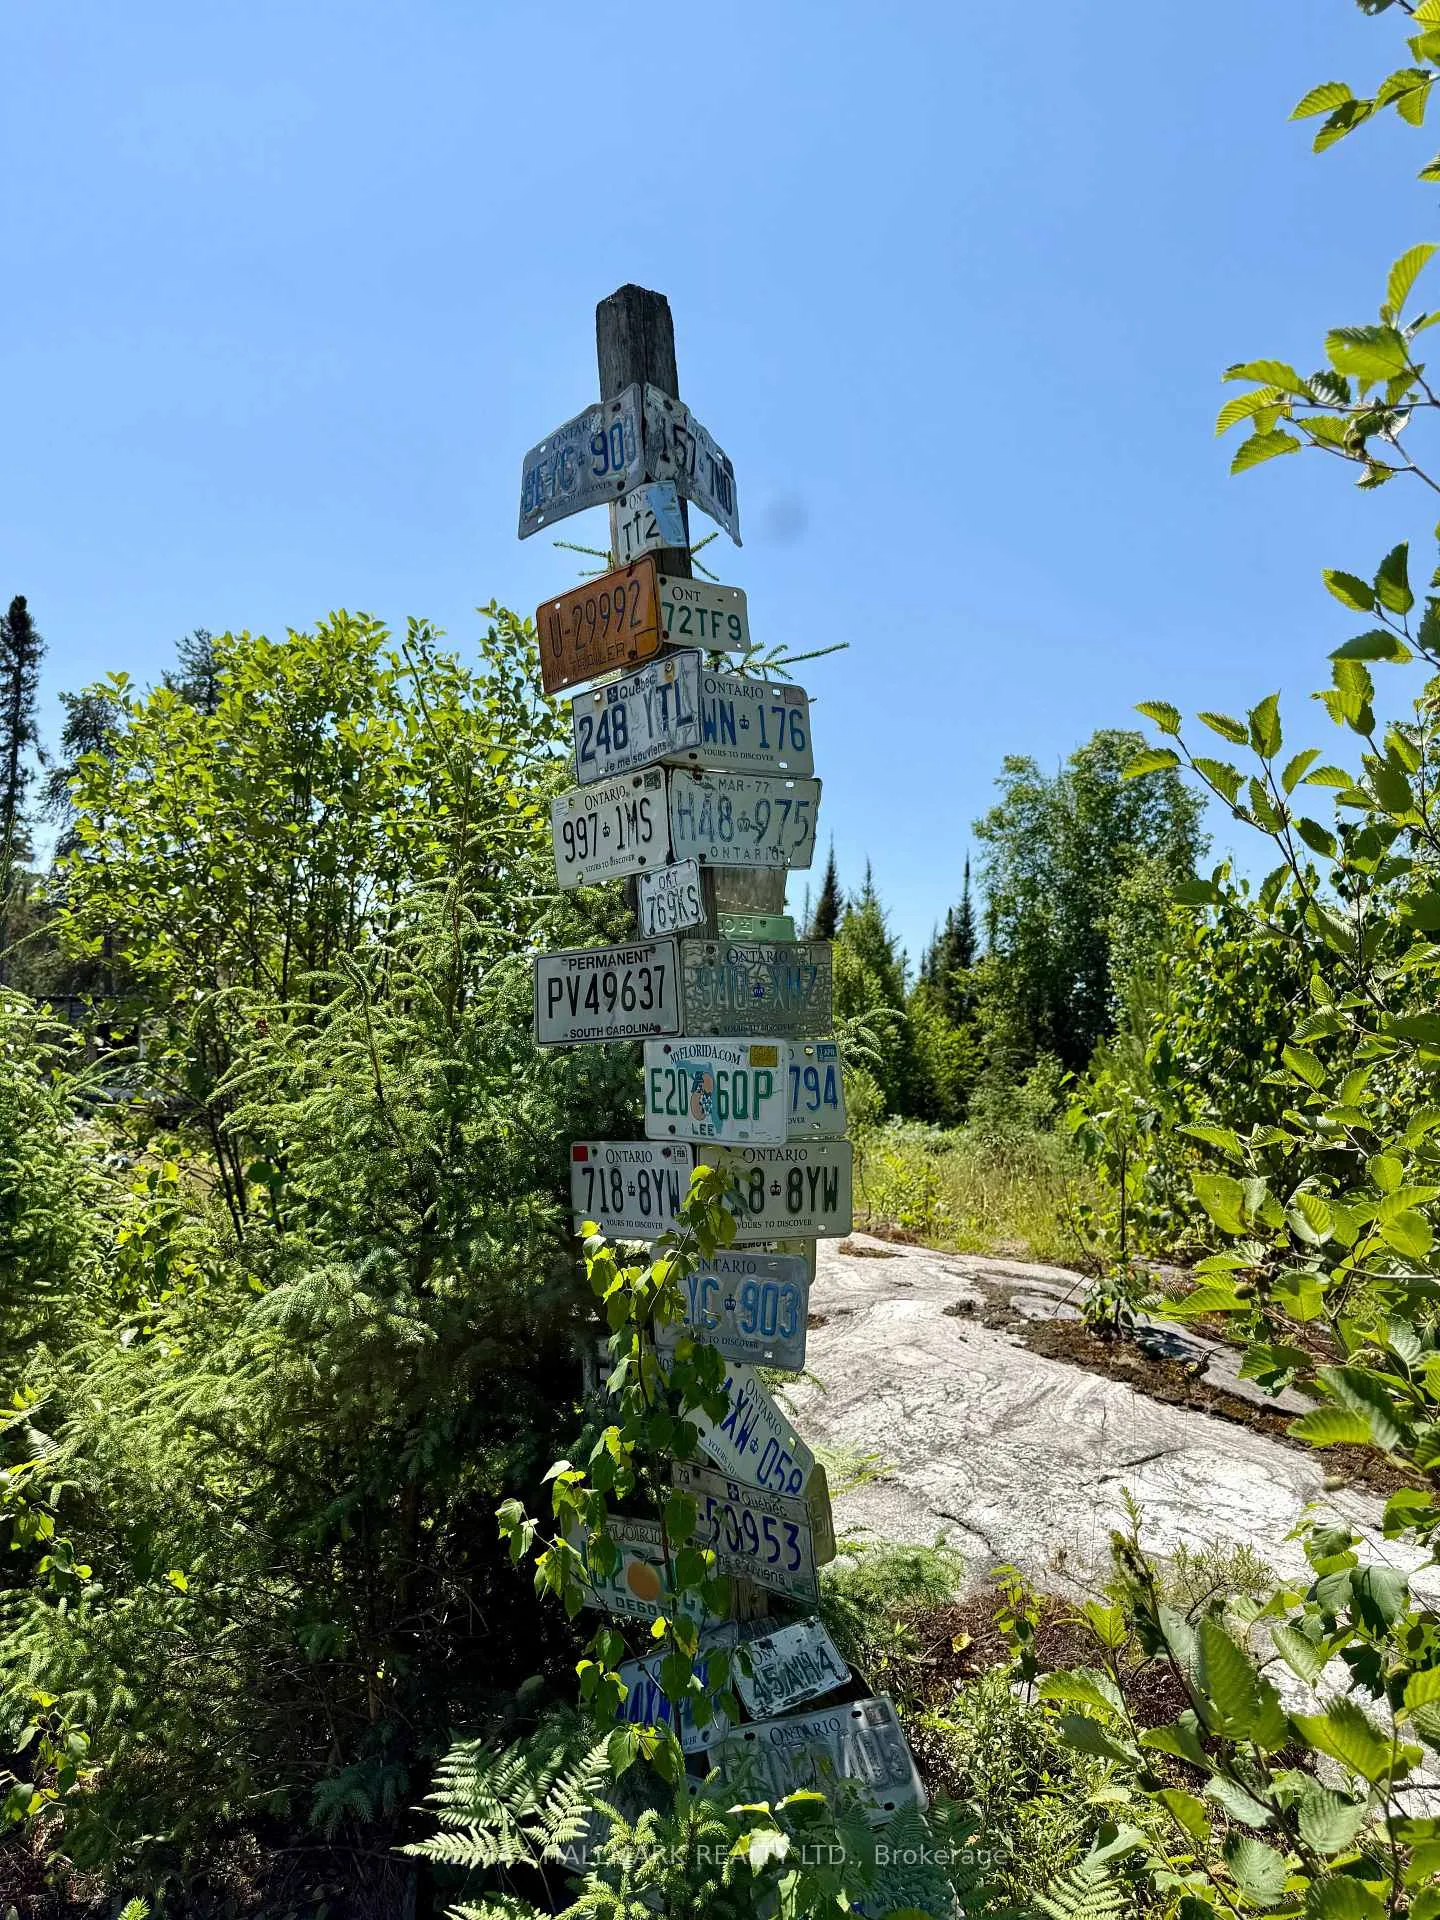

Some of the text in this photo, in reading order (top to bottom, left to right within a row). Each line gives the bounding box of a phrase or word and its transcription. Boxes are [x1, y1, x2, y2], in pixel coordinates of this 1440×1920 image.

[672, 586, 701, 601] ONT
[549, 579, 641, 658] U-29992
[662, 602, 742, 641] 72TF9
[704, 678, 764, 699] ONTARIO
[578, 703, 628, 763] 248
[702, 697, 806, 752] WN 176
[604, 740, 668, 773] Je me souviens
[703, 748, 774, 761] YOURS TO DISCOVER
[584, 785, 626, 811] ONTARIO
[562, 797, 653, 863] 997 1MS
[755, 798, 810, 847] 975
[710, 845, 780, 861] ONTARIO
[658, 870, 678, 890] ONT
[568, 949, 650, 971] PERMANENT
[726, 948, 789, 965] ONTARIO
[547, 964, 665, 1019] PV49637
[569, 1022, 656, 1039] SOUTH CAROLINA
[670, 1044, 741, 1066] MYFLORIDA.COM
[651, 1067, 688, 1116] E20
[788, 1064, 839, 1112] 794
[692, 1123, 715, 1137] LEE
[605, 1148, 653, 1165] ONTARIO
[743, 1147, 808, 1164] ONTARIO
[582, 1167, 681, 1217] 718 8YW
[787, 1166, 839, 1214] 8YW
[606, 1219, 624, 1227] YOURS
[626, 1220, 634, 1228] TO
[737, 1218, 812, 1229] YOURS TO DISCOVER
[701, 1258, 757, 1275] NTARIO
[684, 1274, 800, 1338] YC 903
[708, 1336, 720, 1345] TO
[721, 1337, 759, 1350] DISCOVER
[746, 1378, 782, 1436] ONTARIO
[720, 1388, 760, 1455] XW
[707, 1439, 728, 1465] YOURS
[678, 1468, 690, 1485] 79
[770, 1717, 841, 1747] ONTARIO
